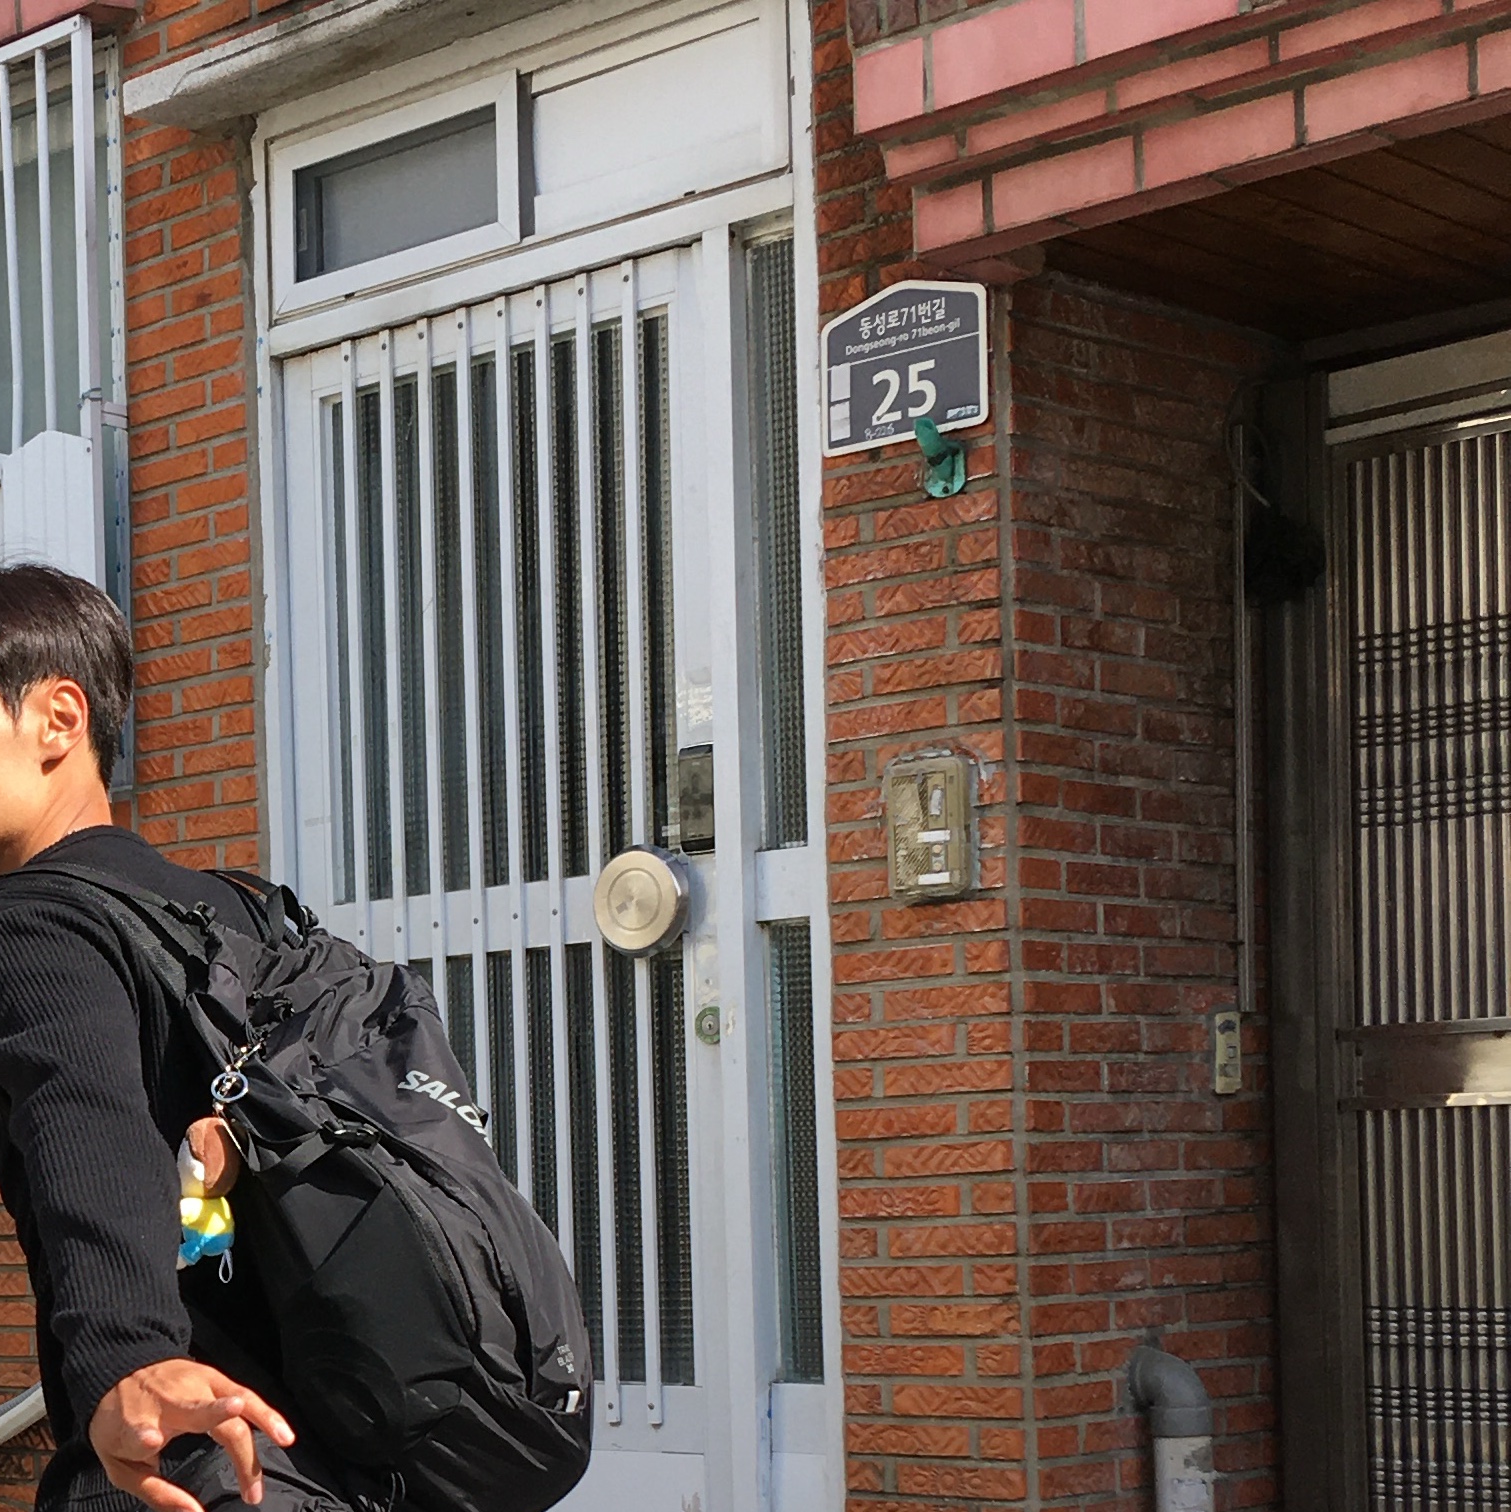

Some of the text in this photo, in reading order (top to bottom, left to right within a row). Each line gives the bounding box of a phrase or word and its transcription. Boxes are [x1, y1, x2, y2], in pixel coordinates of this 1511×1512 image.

[845, 317, 961, 355] Dongseong-ro 71beon-gil
[859, 297, 946, 340] 동성로71번길
[871, 359, 937, 425] 25
